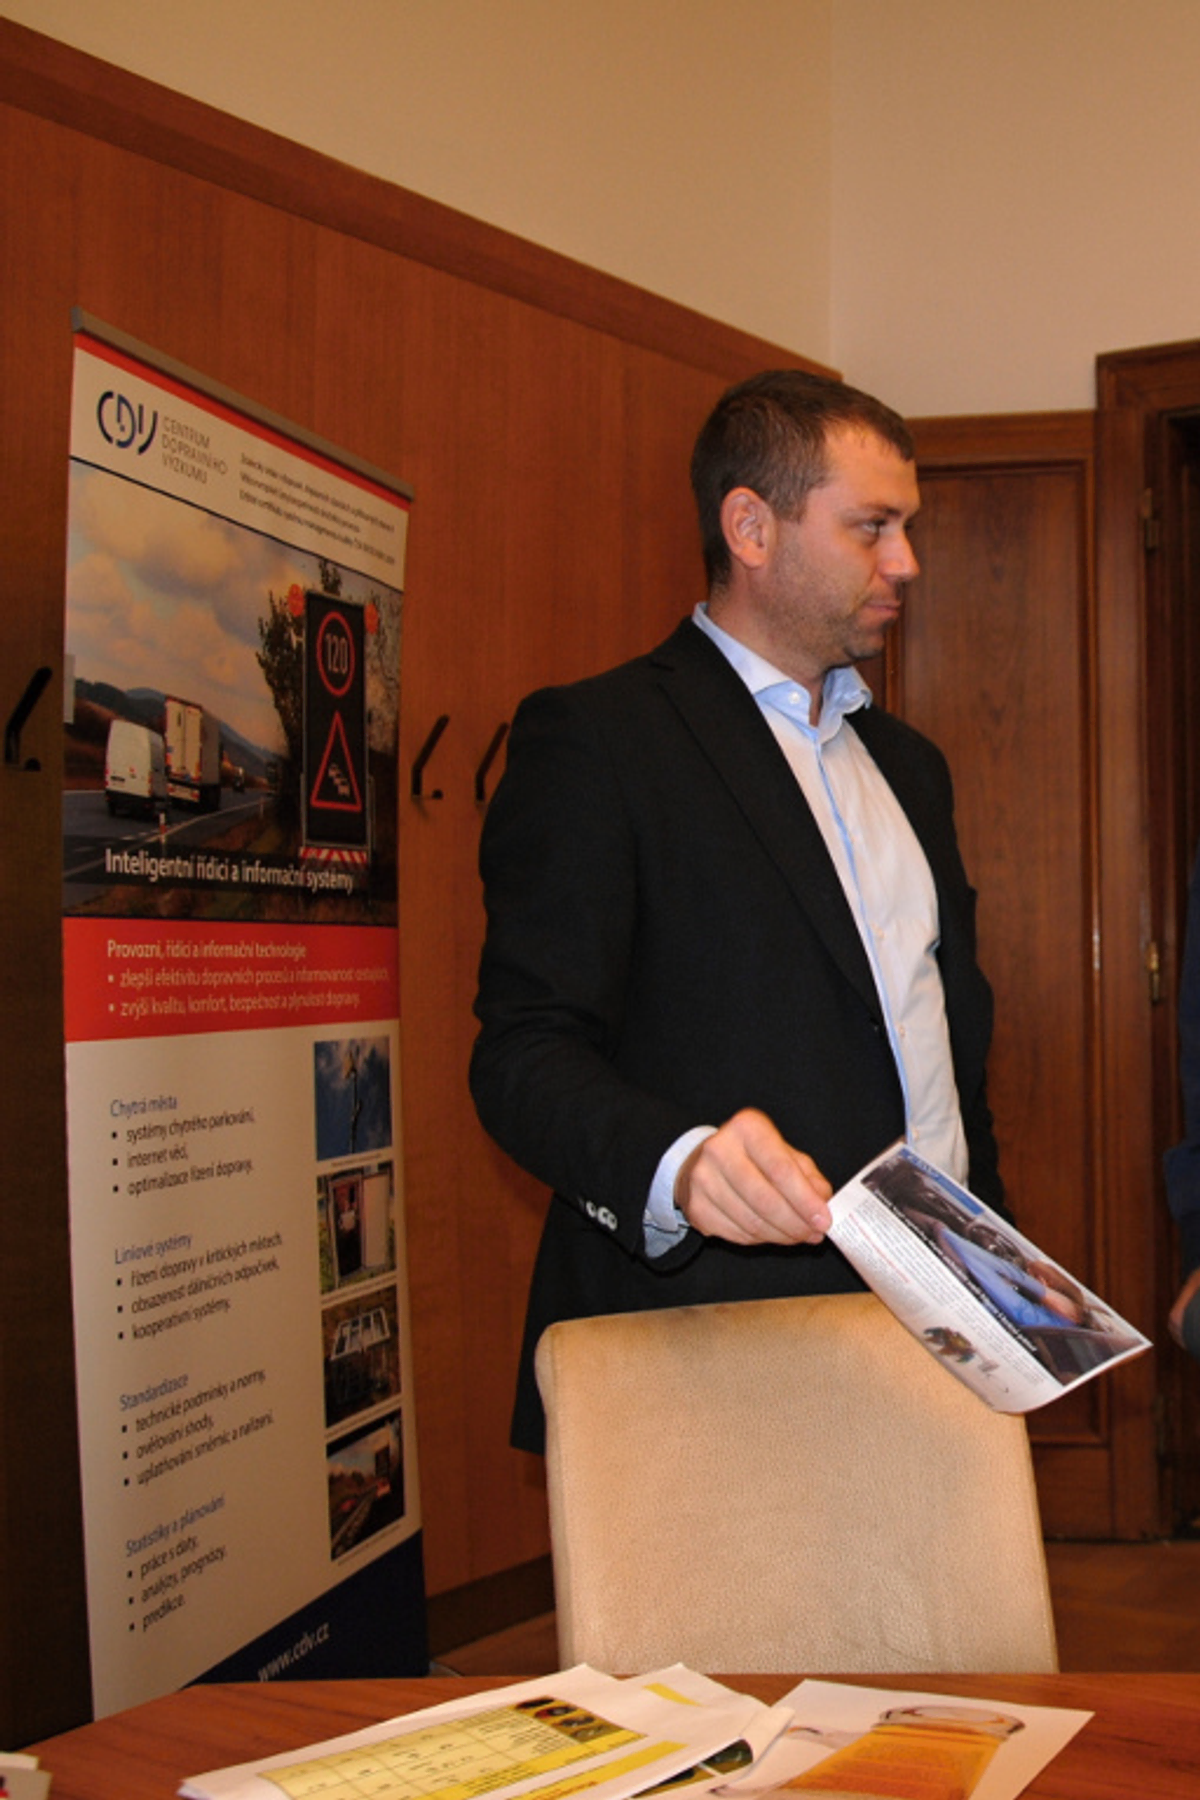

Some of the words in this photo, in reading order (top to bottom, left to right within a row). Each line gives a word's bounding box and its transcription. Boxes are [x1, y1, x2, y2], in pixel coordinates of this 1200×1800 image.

[163, 416, 210, 448] CENTRUM
[105, 848, 194, 882] Inteligentní
[231, 864, 239, 881] a
[241, 860, 305, 887] informační
[306, 866, 354, 896] systémy
[107, 939, 164, 960] Provozní,
[126, 1123, 167, 1146] systémy
[127, 1148, 167, 1169] internet
[159, 1257, 198, 1279] dopravy
[229, 1381, 236, 1393] a
[231, 1428, 238, 1442] a
[257, 1621, 331, 1683] www.cdv.cz
